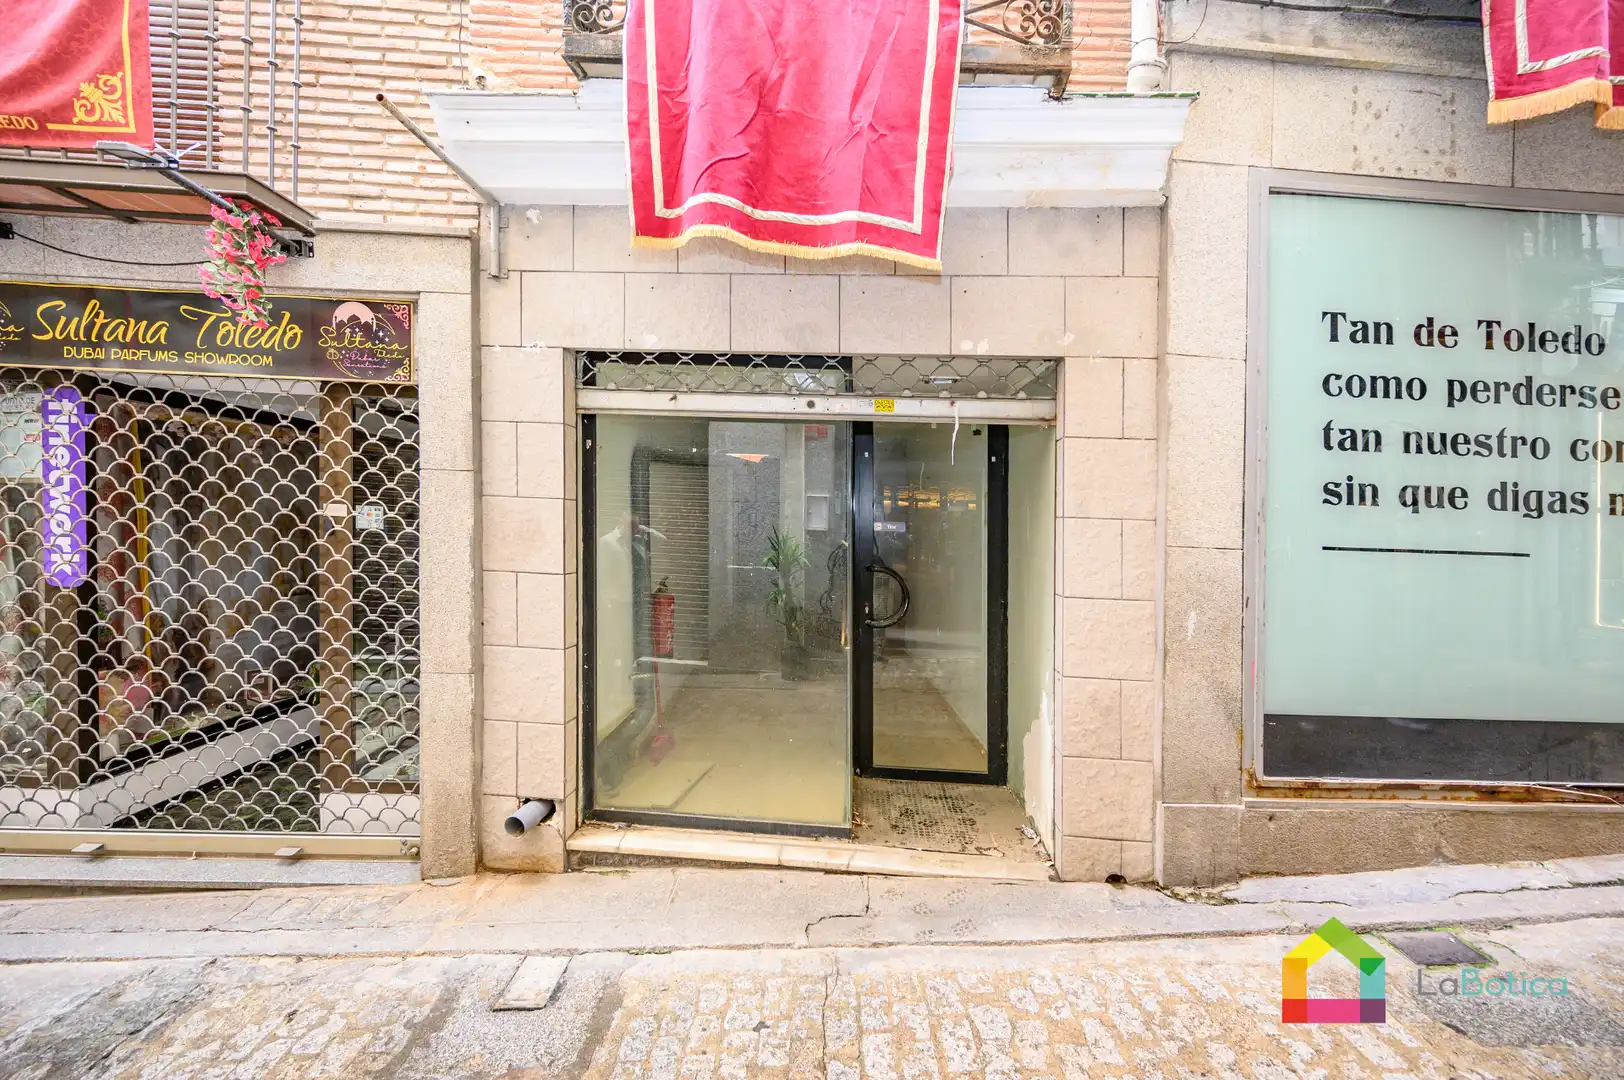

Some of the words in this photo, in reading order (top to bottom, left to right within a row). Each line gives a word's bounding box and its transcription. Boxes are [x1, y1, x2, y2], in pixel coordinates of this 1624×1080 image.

[0, 115, 39, 130] EDO
[32, 299, 168, 345] Sultana
[180, 305, 303, 352] Toledo
[318, 326, 408, 350] Sultana
[1321, 311, 1395, 345] Tan
[1413, 316, 1459, 349] de
[1477, 319, 1606, 356] Toledo
[63, 346, 105, 359] DUBAI
[111, 348, 179, 363] PARFUMS
[185, 351, 273, 367] SHOWROOM
[1322, 372, 1427, 401] como
[1446, 375, 1622, 411] perderse
[1322, 419, 1383, 453] tan
[1402, 427, 1551, 460] nuestro
[1322, 475, 1380, 507] sin
[1398, 482, 1469, 514] que
[1487, 481, 1590, 520] digas
